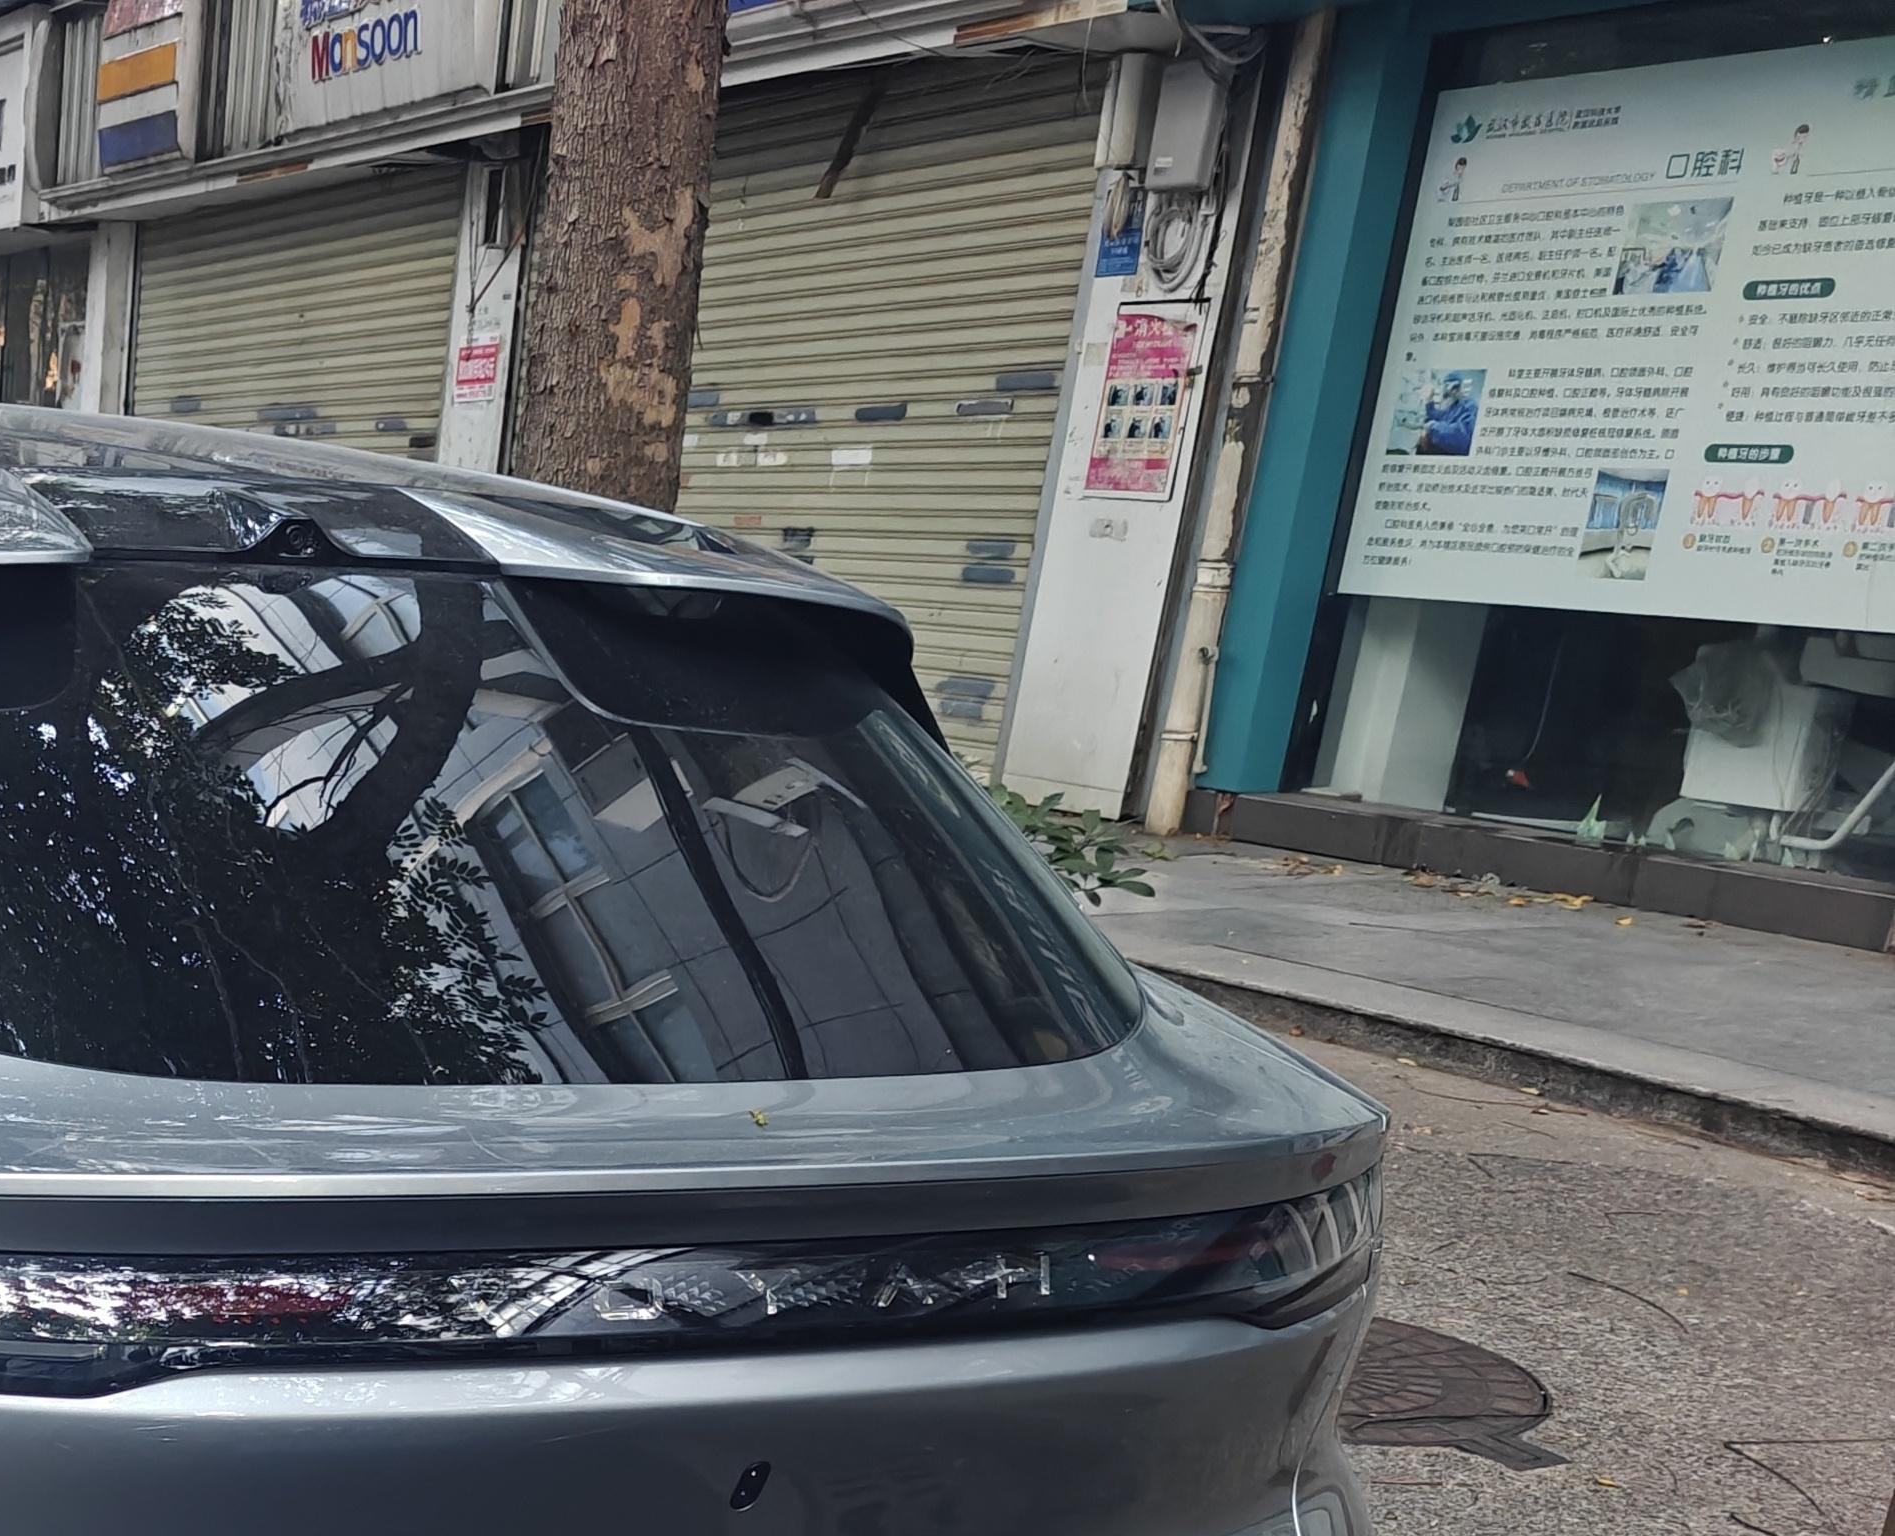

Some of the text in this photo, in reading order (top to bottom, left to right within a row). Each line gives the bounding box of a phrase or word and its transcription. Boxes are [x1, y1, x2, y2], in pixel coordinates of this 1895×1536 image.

[311, 8, 420, 81] Monsoon
[1665, 148, 1745, 180] 口腔科
[1566, 176, 1580, 189] OF
